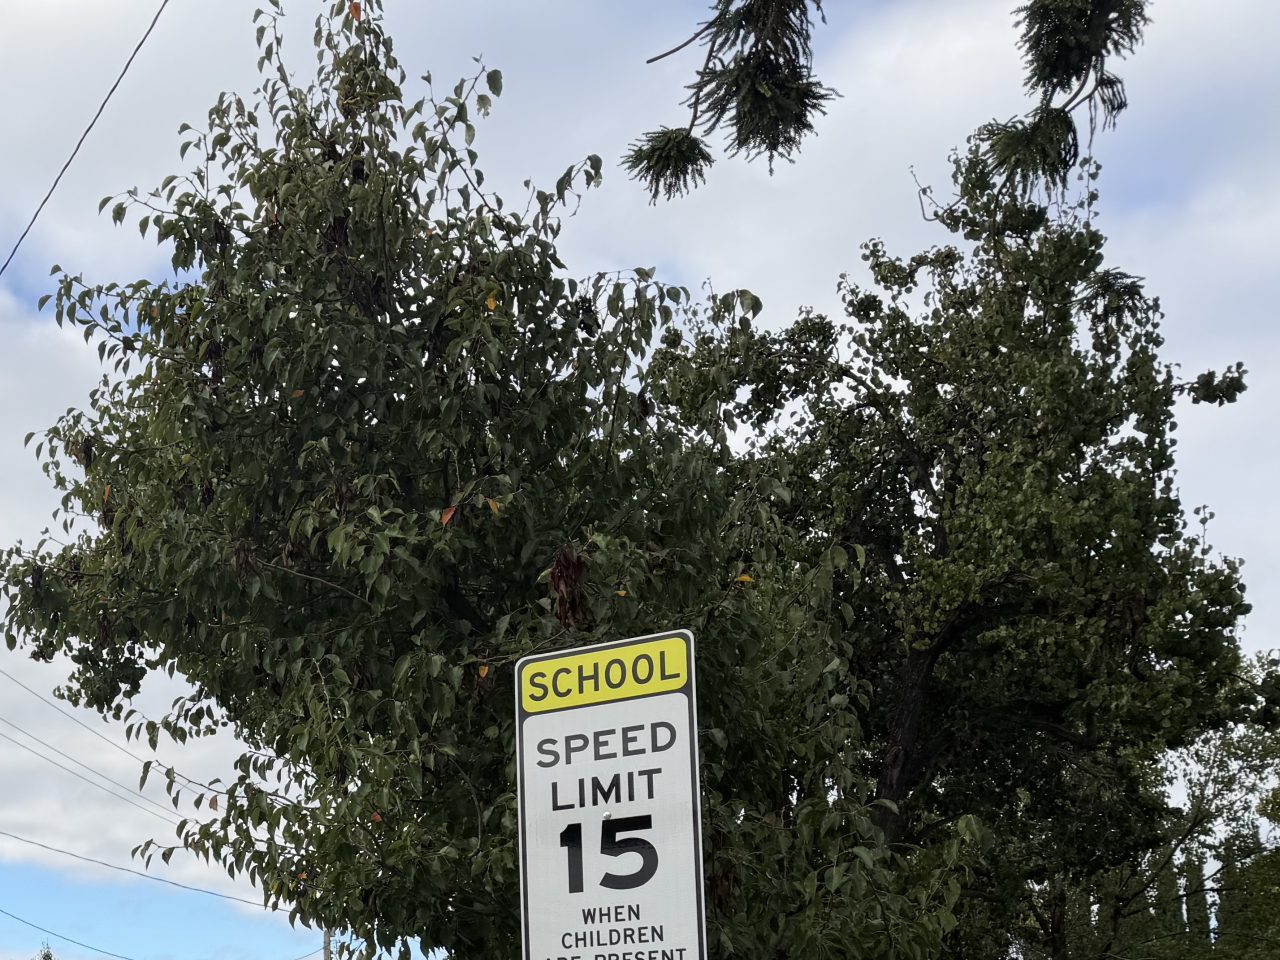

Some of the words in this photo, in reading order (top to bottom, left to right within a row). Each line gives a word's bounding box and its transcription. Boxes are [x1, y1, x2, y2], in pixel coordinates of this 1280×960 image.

[529, 650, 681, 701] SCHOOL
[536, 721, 677, 768] SPEED
[551, 768, 662, 811] LIMIT
[559, 814, 659, 894] 15
[561, 925, 664, 949] CHILDREN
[582, 904, 640, 925] WHEN
